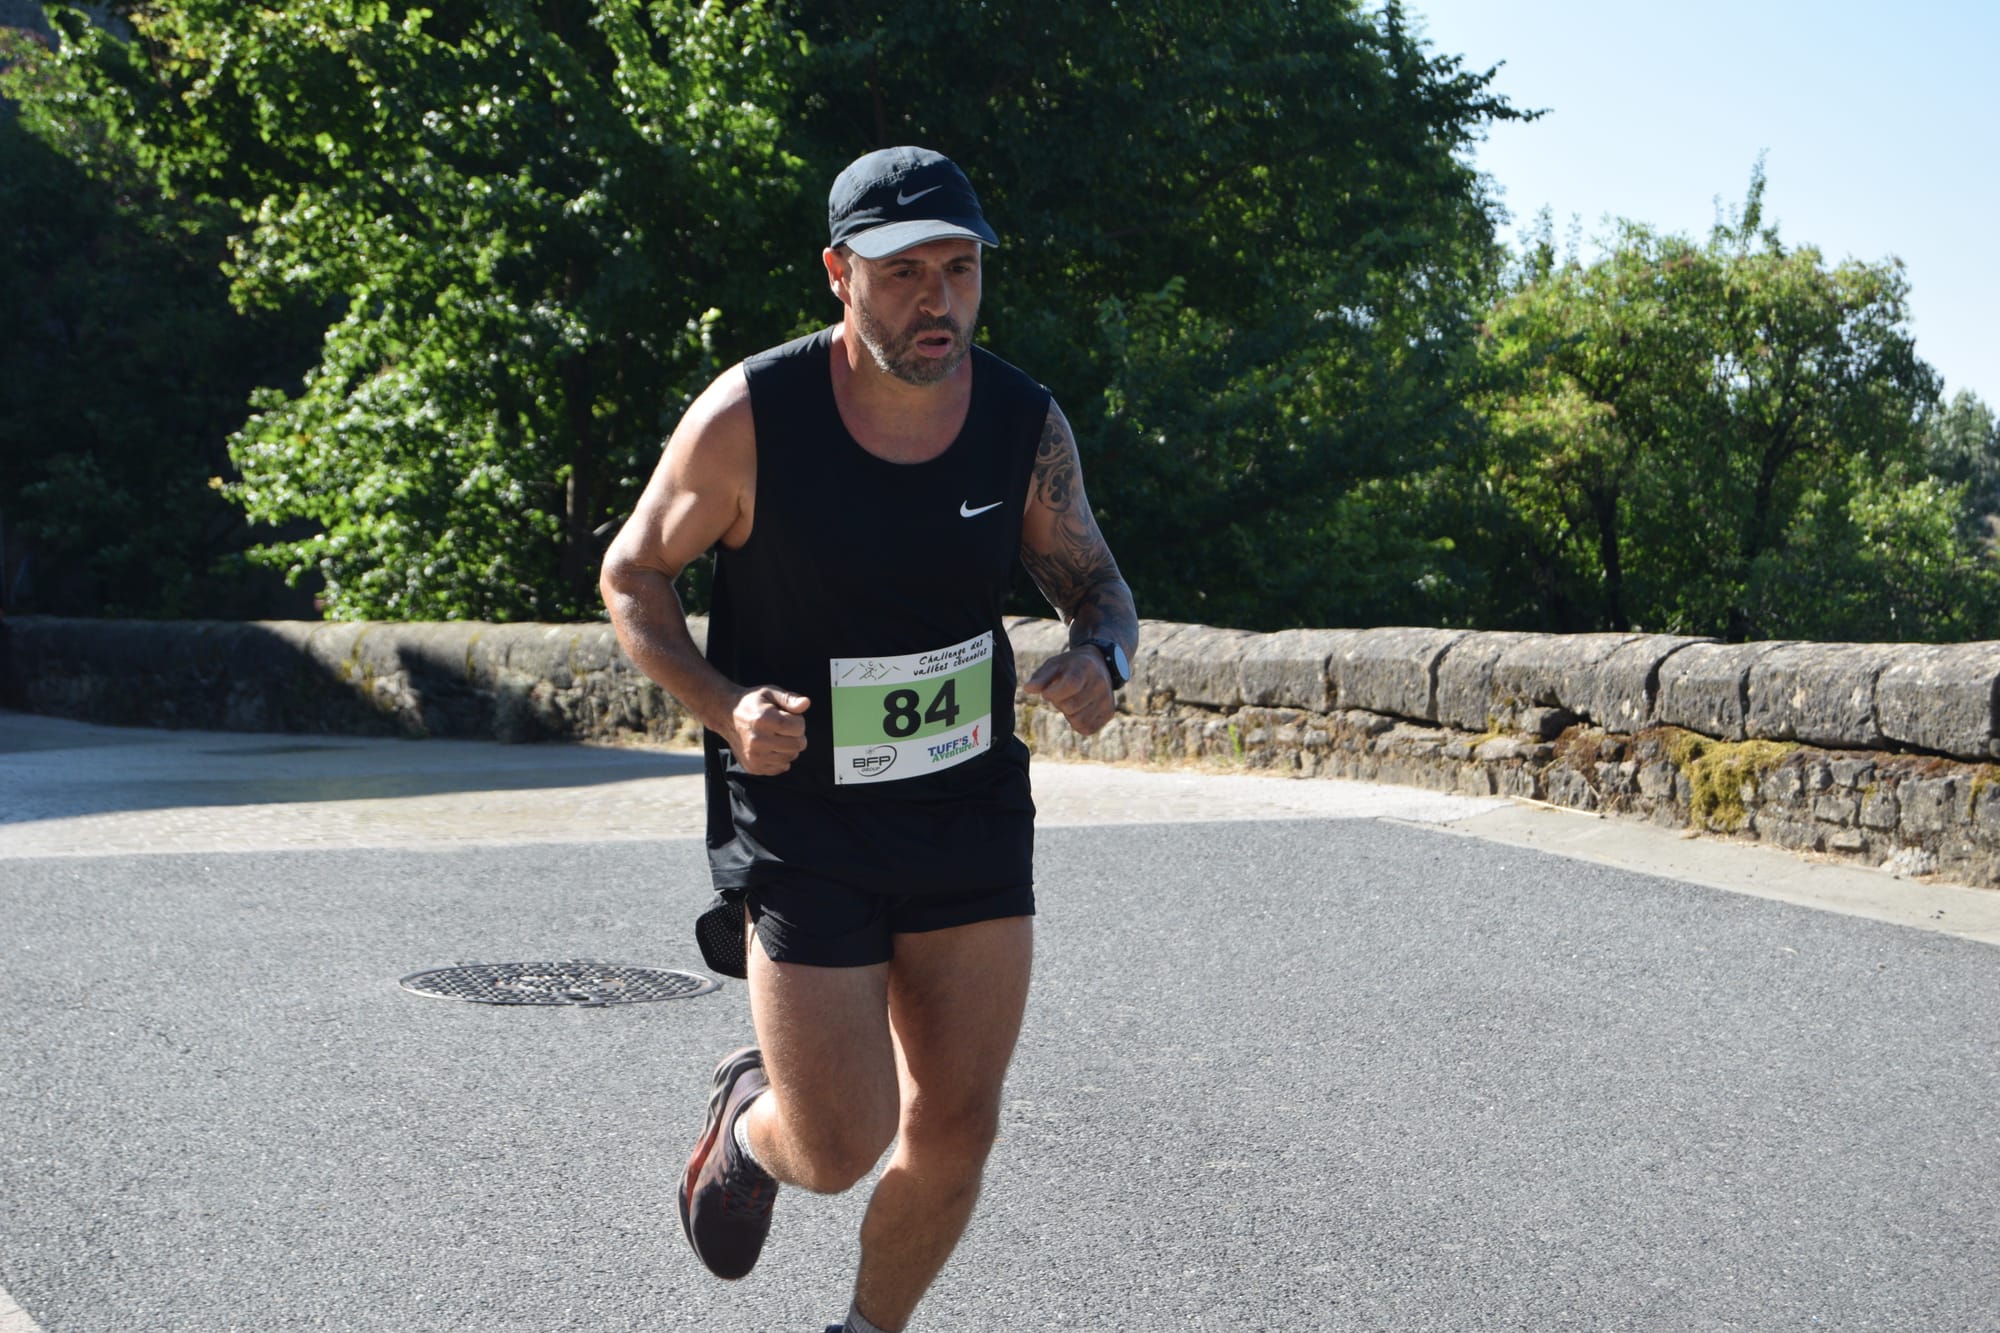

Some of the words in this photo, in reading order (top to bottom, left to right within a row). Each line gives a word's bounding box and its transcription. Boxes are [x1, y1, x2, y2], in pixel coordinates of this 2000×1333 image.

[919, 648, 966, 665] Challenge
[970, 639, 984, 650] des
[882, 678, 960, 738] 84
[927, 735, 969, 756] TUFF'S
[852, 755, 891, 768] BFP
